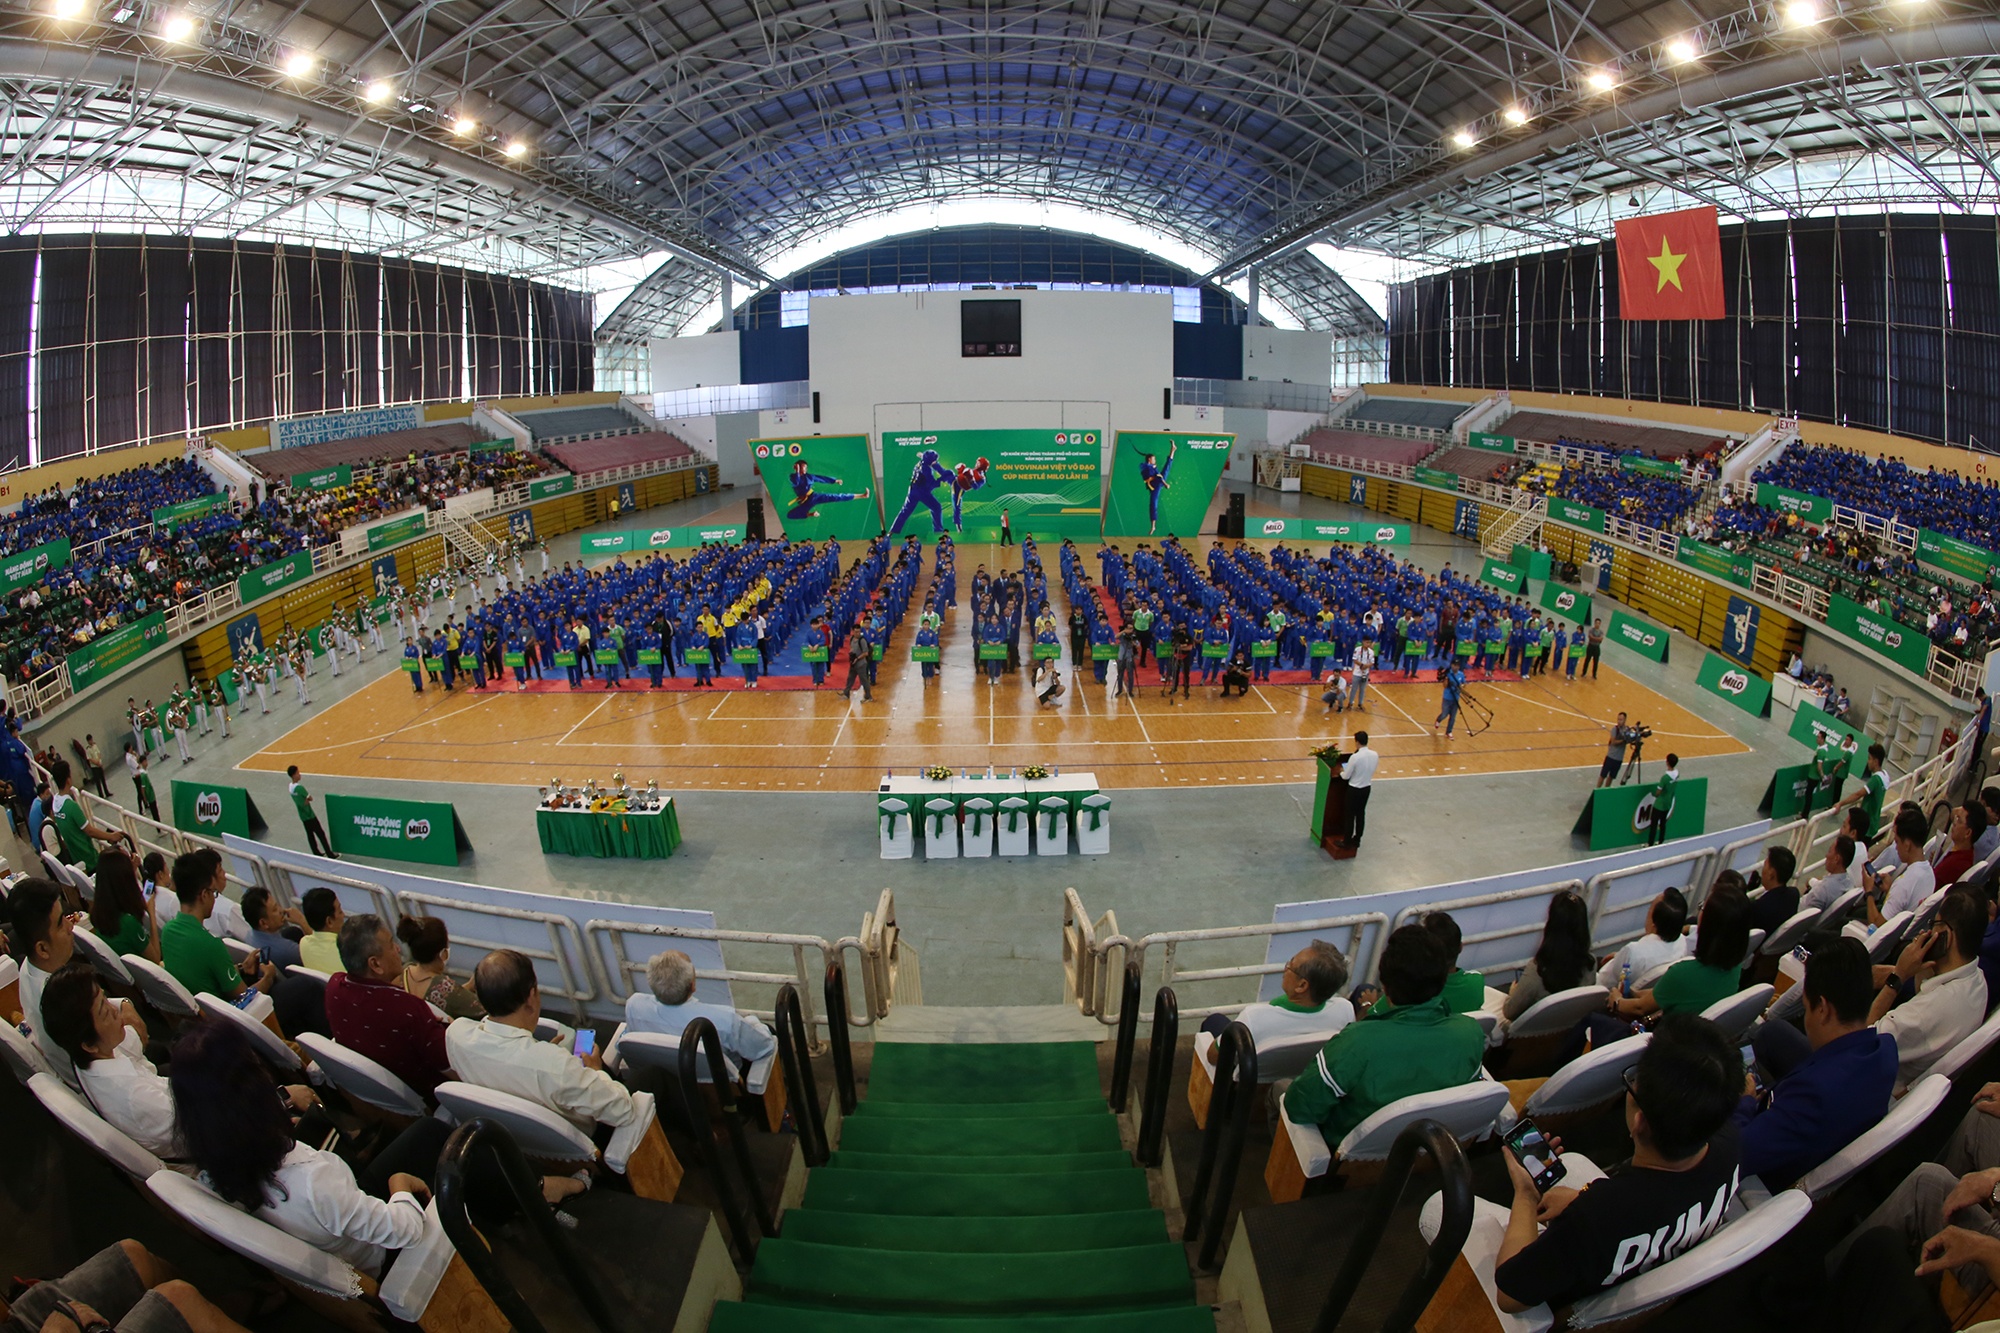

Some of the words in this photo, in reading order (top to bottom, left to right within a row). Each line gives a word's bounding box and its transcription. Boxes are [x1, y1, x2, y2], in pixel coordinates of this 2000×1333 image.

[1780, 420, 1796, 429] EXIT
[187, 438, 204, 448] EXIT
[1050, 463, 1066, 472] VIỆT
[1976, 463, 1986, 474] C1
[0, 486, 10, 496] B1
[1558, 597, 1572, 606] MILO
[1722, 676, 1744, 690] MILO
[199, 802, 219, 816] MILO
[361, 826, 380, 838] VIỆT
[380, 828, 400, 839] NAM
[409, 825, 428, 835] MILO
